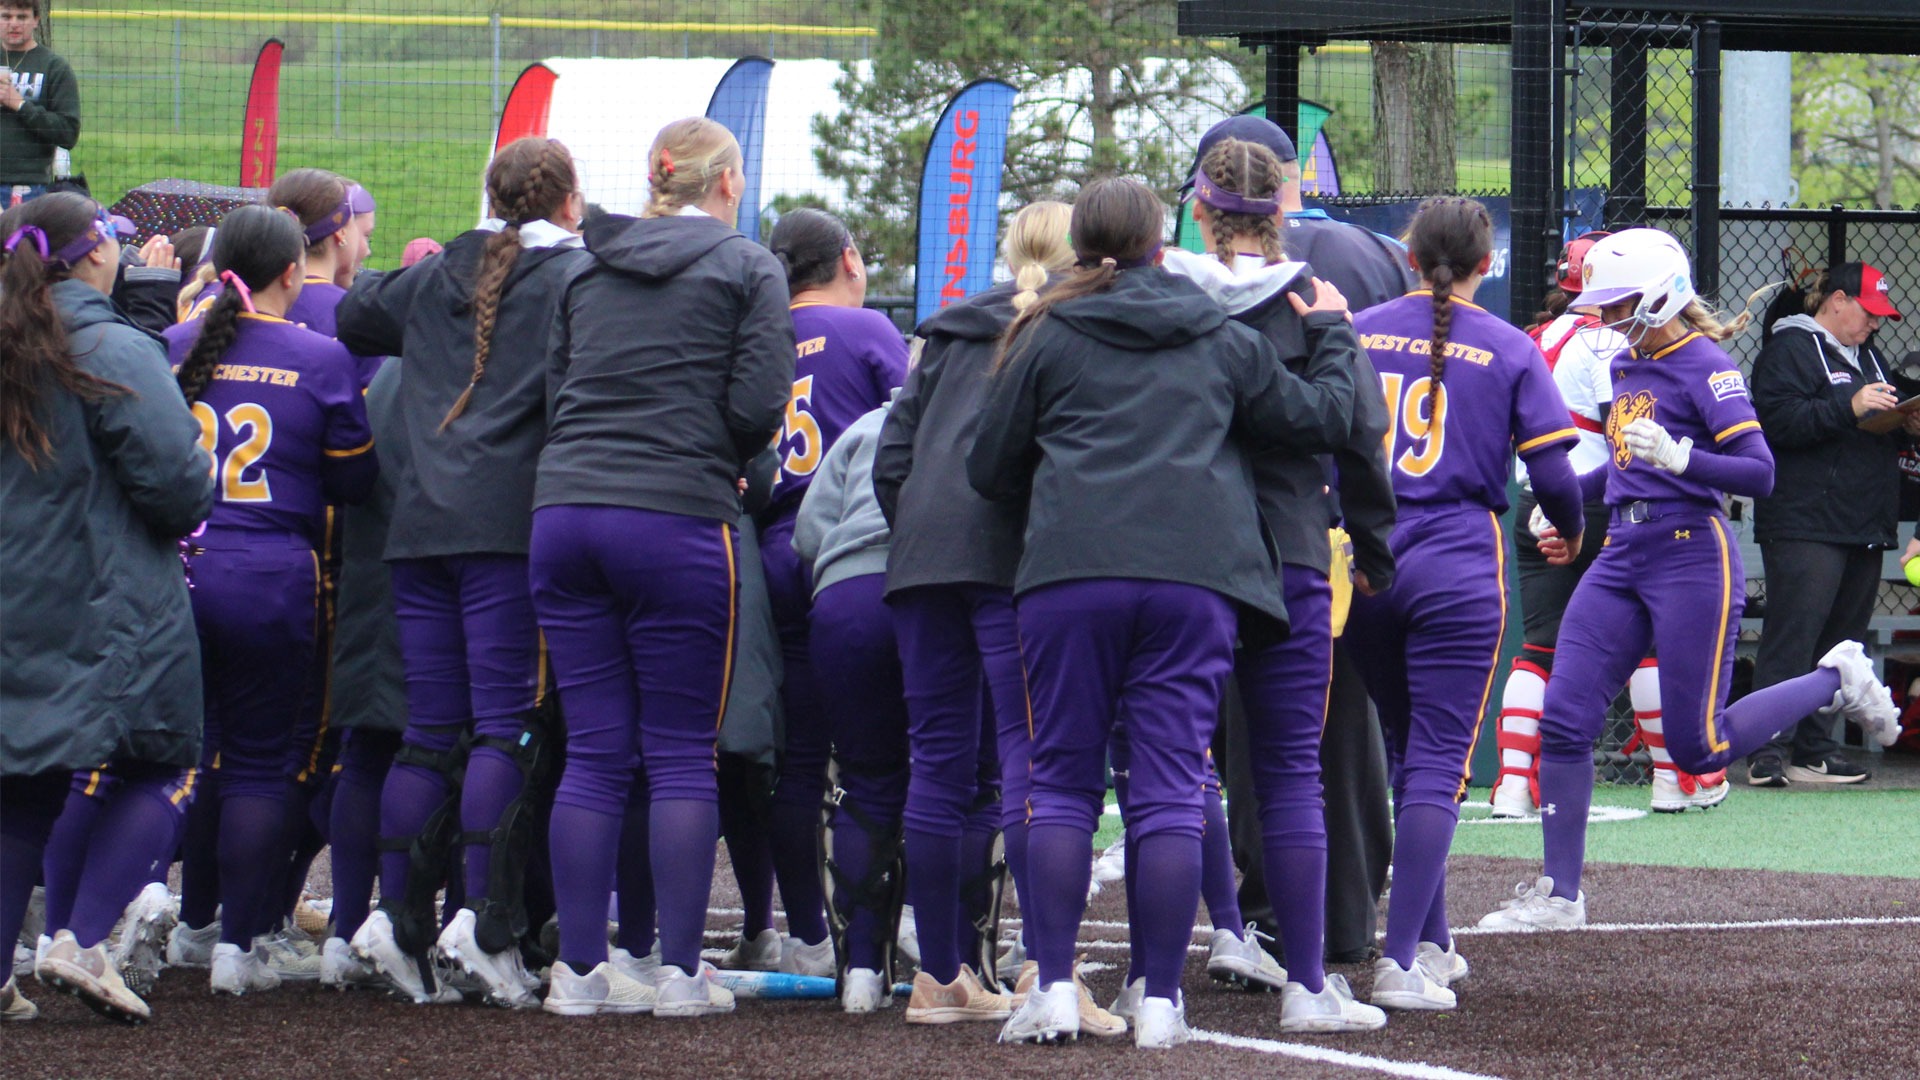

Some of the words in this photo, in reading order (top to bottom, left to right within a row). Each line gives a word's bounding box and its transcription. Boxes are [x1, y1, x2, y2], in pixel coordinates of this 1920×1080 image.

[941, 109, 979, 308] NSBURG
[796, 336, 826, 358] TER
[1360, 334, 1410, 352] WEST
[1409, 338, 1494, 366] CHSTER
[212, 364, 300, 387] CHESTER
[1712, 376, 1744, 394] PSA
[772, 374, 823, 485] 5
[1380, 371, 1448, 478] 19
